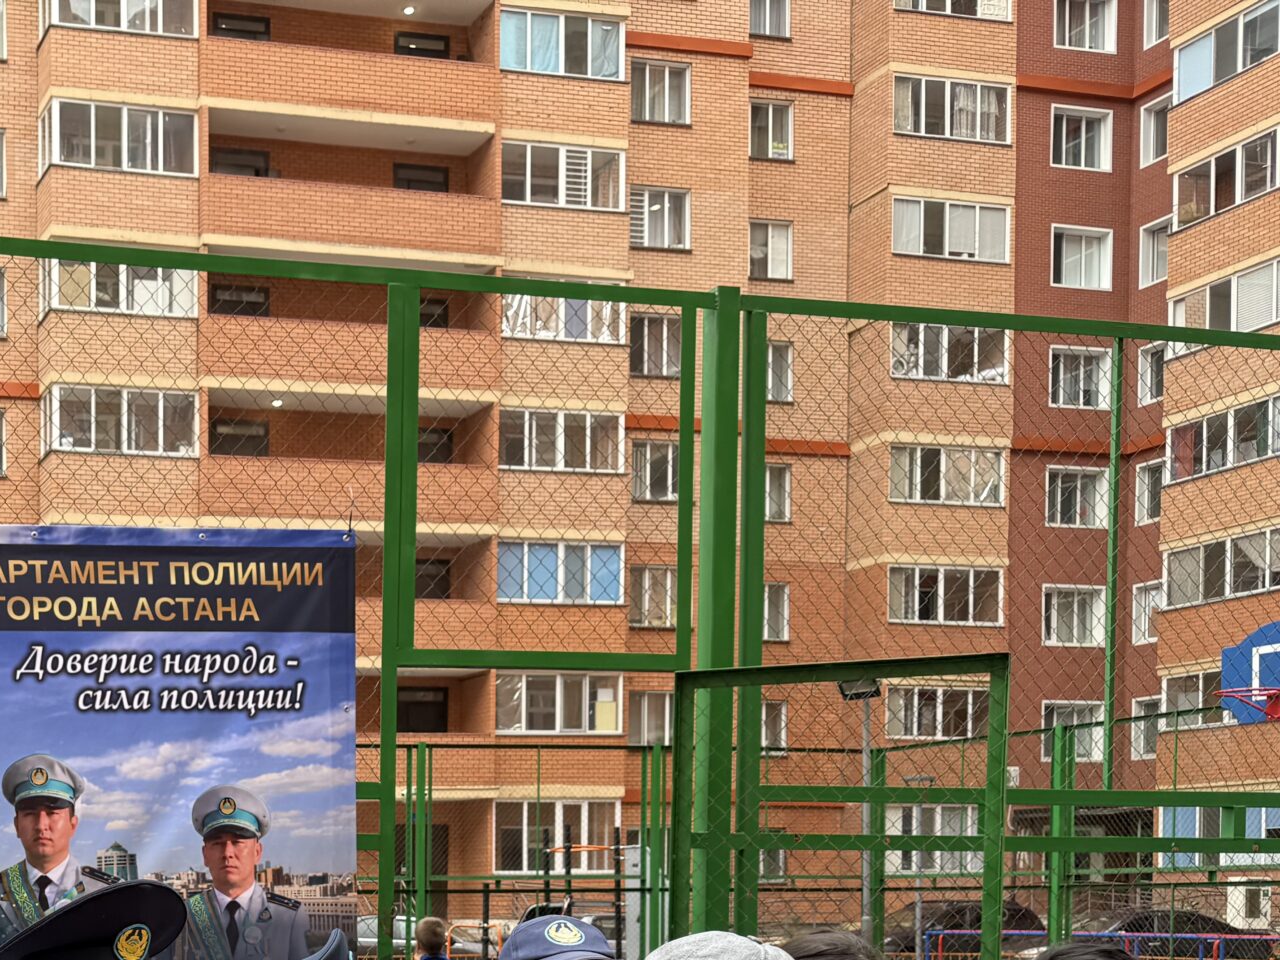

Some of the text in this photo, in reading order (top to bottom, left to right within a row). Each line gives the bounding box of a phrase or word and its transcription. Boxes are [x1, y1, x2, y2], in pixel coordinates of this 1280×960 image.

[169, 561, 323, 592] ПОЛИЦИИ
[132, 596, 260, 622] АСТАНА
[16, 646, 154, 683] Доверие
[163, 647, 277, 682] народа
[78, 683, 305, 716] сила полиции!
